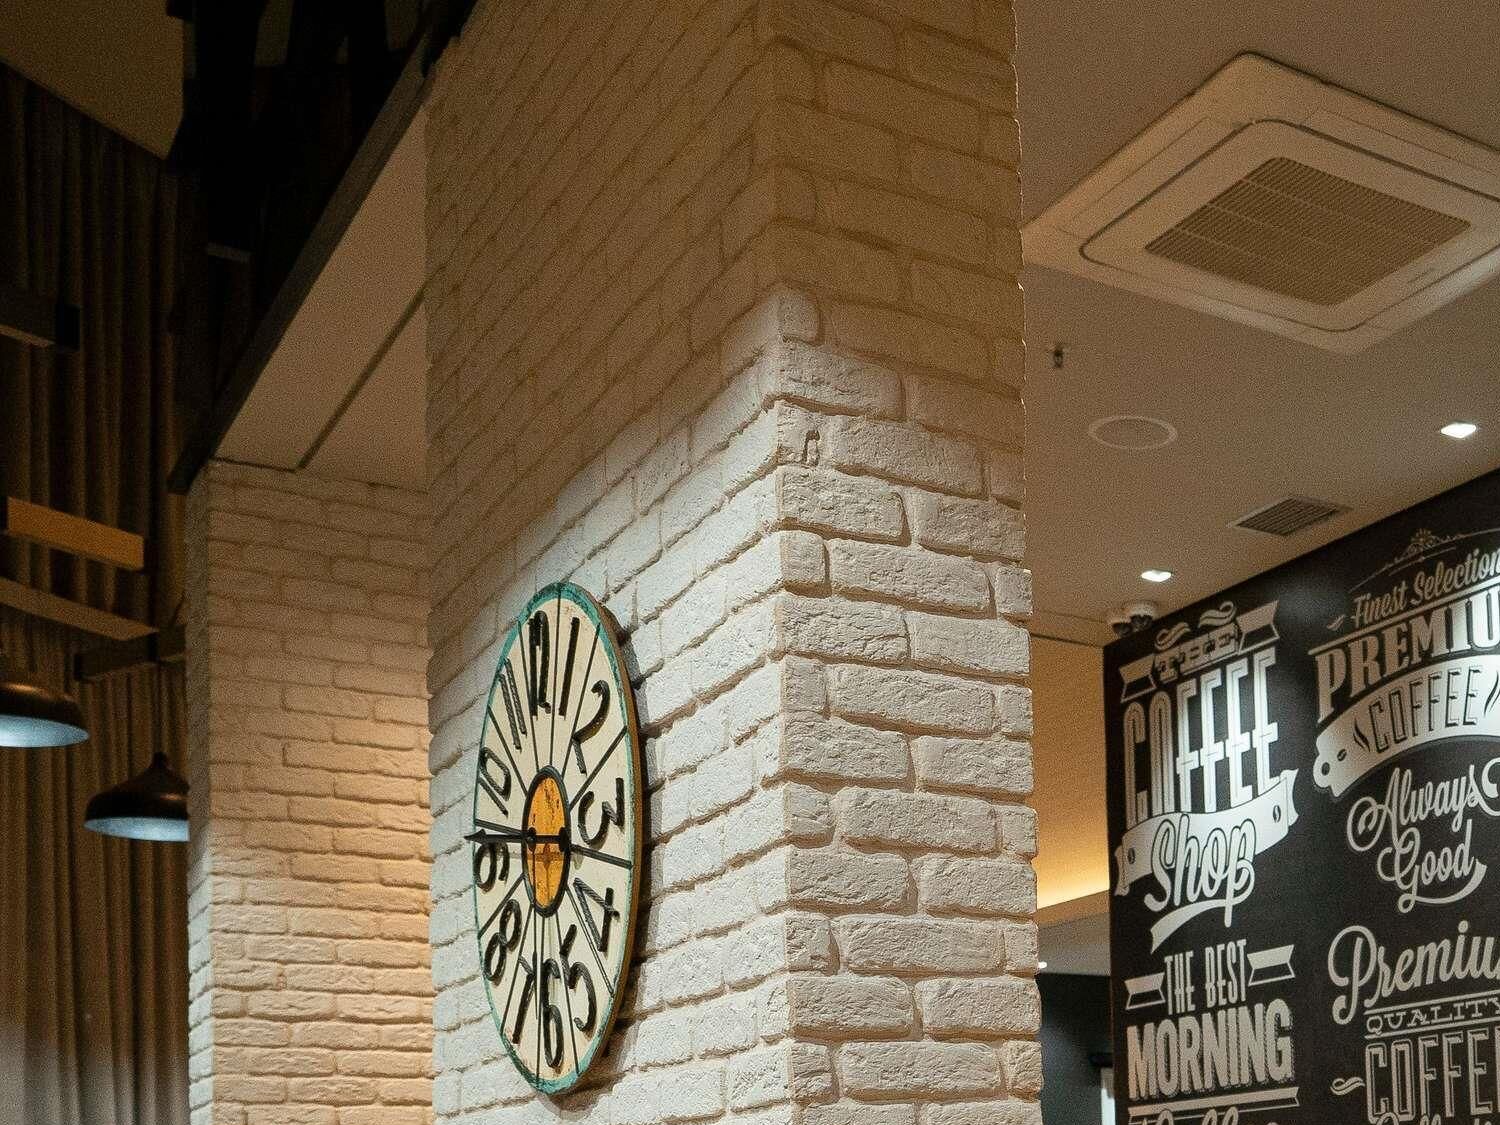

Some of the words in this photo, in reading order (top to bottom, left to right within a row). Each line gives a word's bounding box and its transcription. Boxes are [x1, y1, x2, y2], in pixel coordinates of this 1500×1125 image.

[1154, 623, 1239, 683] THE
[1350, 590, 1407, 628] Finest
[499, 657, 527, 750] 11
[558, 616, 580, 717] 1
[1369, 665, 1482, 754] COFFEE
[572, 680, 610, 774] 2
[1124, 647, 1278, 830] COFFEE
[578, 777, 624, 846] 3
[1144, 813, 1256, 926] Shop
[1377, 820, 1486, 912] Good
[484, 899, 521, 982] 8
[573, 877, 619, 952] 4
[559, 924, 597, 1031] 5
[1165, 954, 1193, 1016] THE
[1205, 938, 1248, 1009] BEST
[1127, 999, 1293, 1100] MORNING
